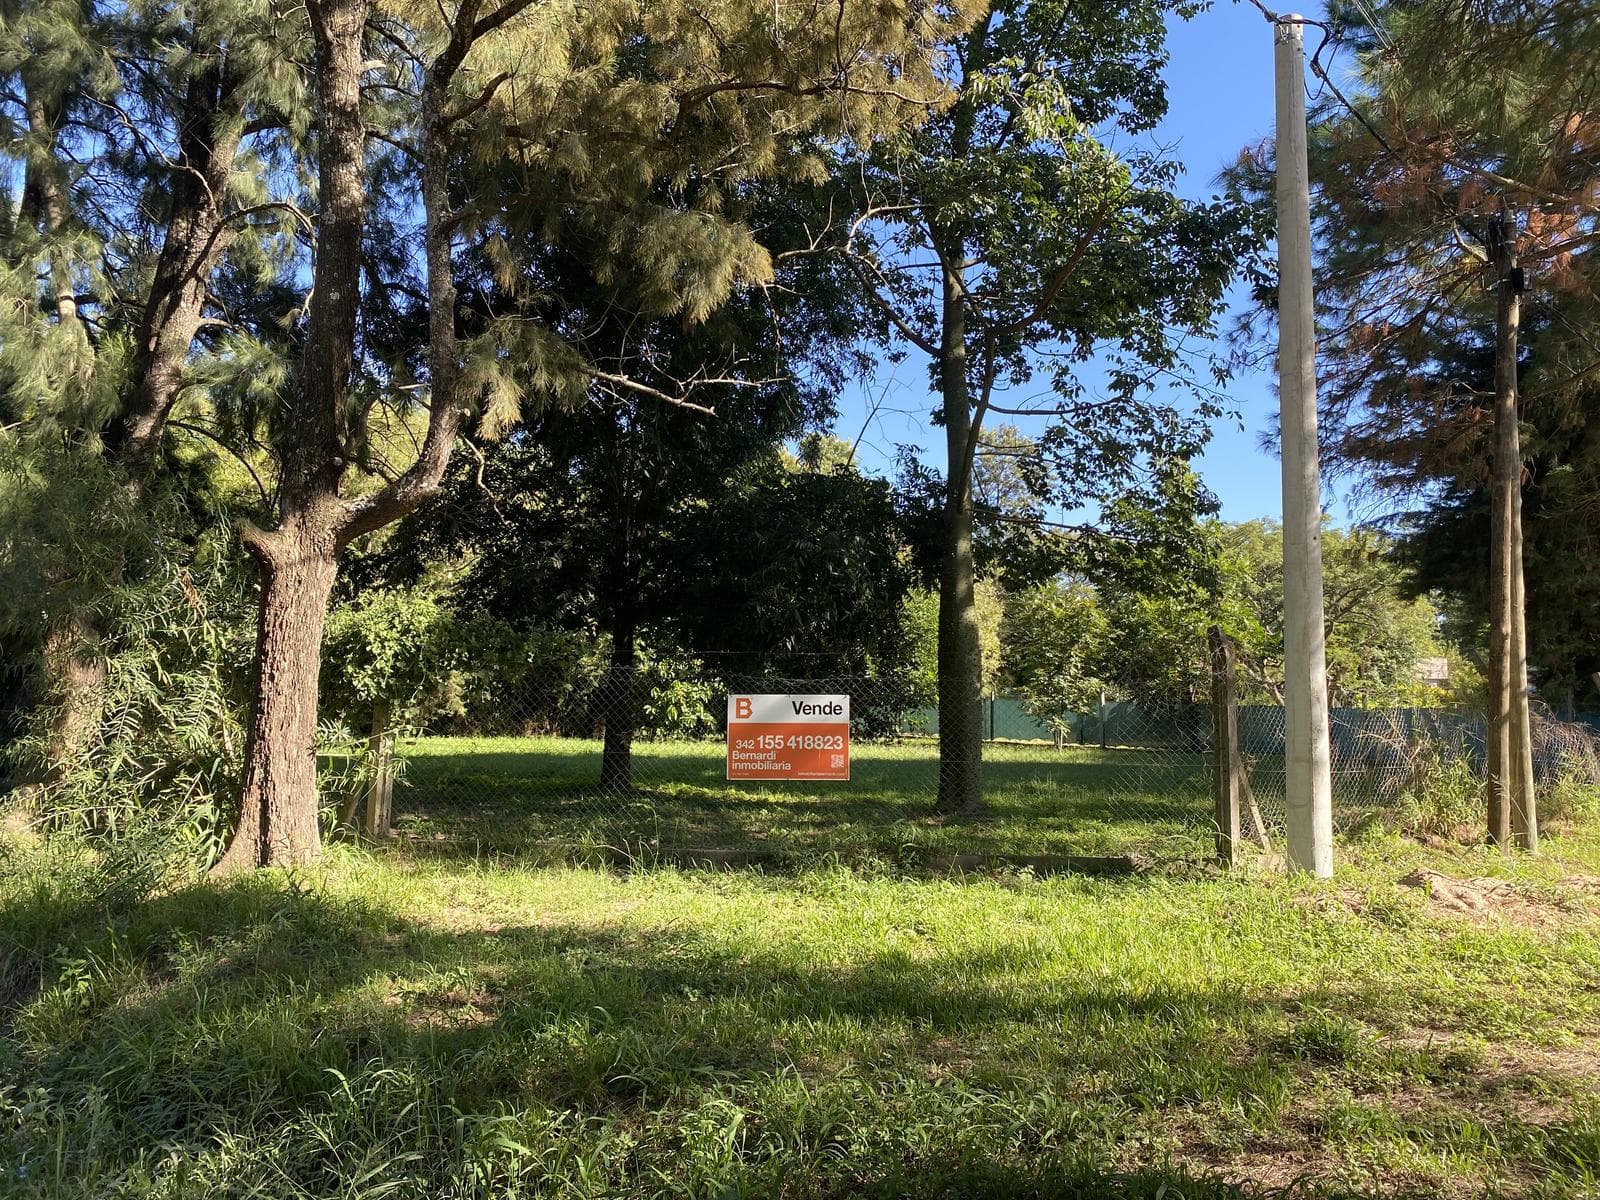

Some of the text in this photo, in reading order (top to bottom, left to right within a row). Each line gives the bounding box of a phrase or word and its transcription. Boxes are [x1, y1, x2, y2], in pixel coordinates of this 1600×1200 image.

[736, 698, 752, 719] B
[792, 701, 842, 715] Vende
[736, 735, 843, 749] 342 155 418823
[732, 751, 776, 760] Bernardi
